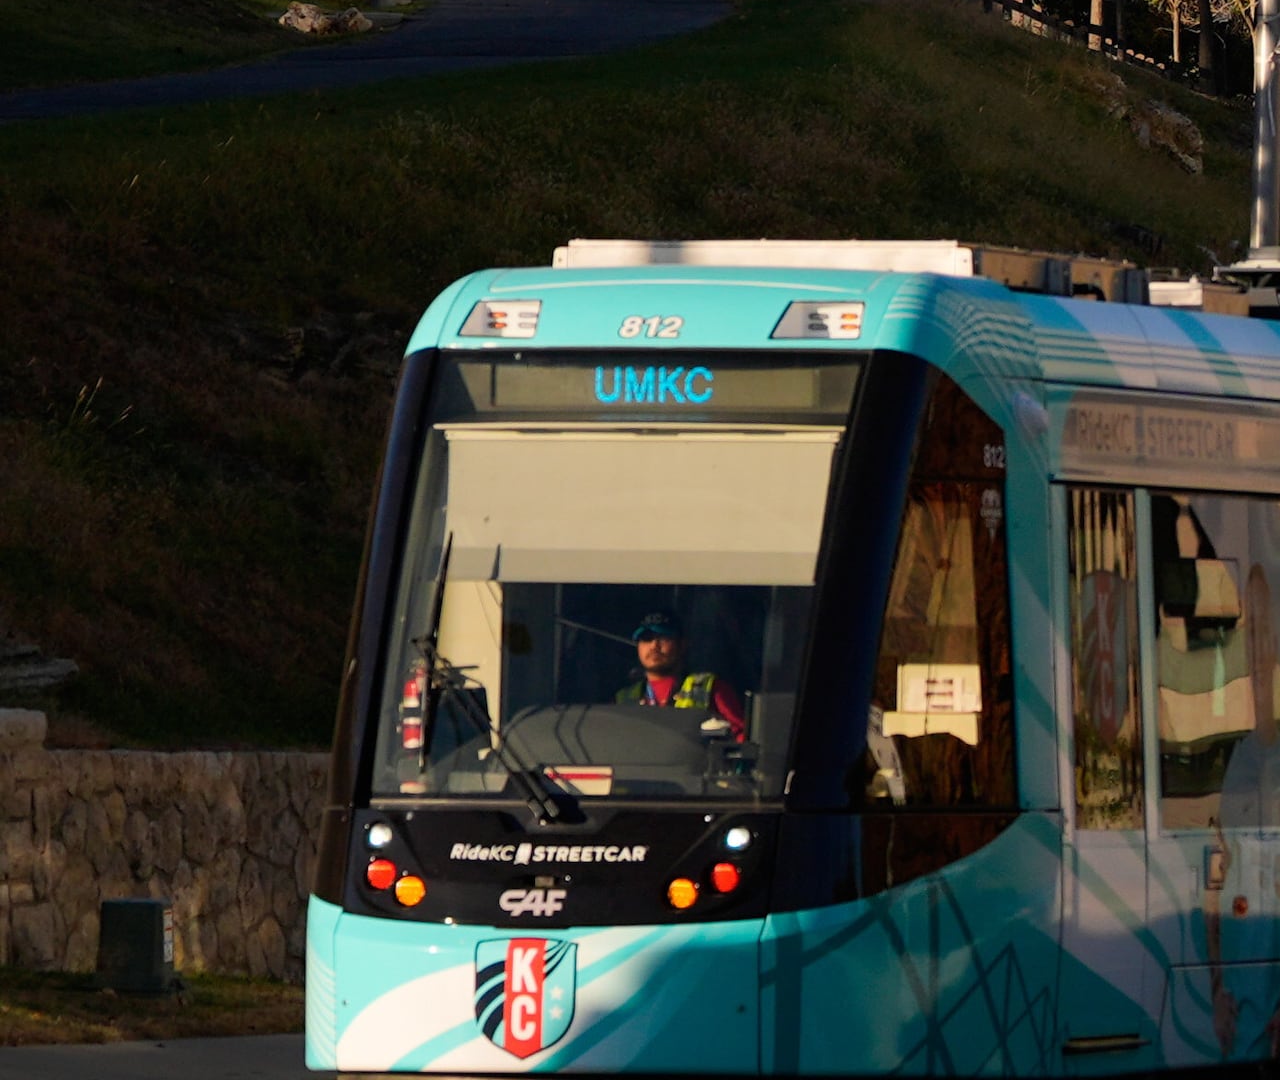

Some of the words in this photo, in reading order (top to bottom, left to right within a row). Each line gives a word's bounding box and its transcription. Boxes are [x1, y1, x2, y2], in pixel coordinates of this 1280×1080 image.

[618, 315, 684, 339] 812
[594, 365, 714, 404] UMKC
[1148, 415, 1235, 459] STREETCAR
[983, 443, 1005, 469] 812
[450, 842, 516, 861] RideKC
[532, 845, 648, 862] STREETCAR
[499, 888, 568, 917] CAF
[511, 946, 538, 1041] KC
